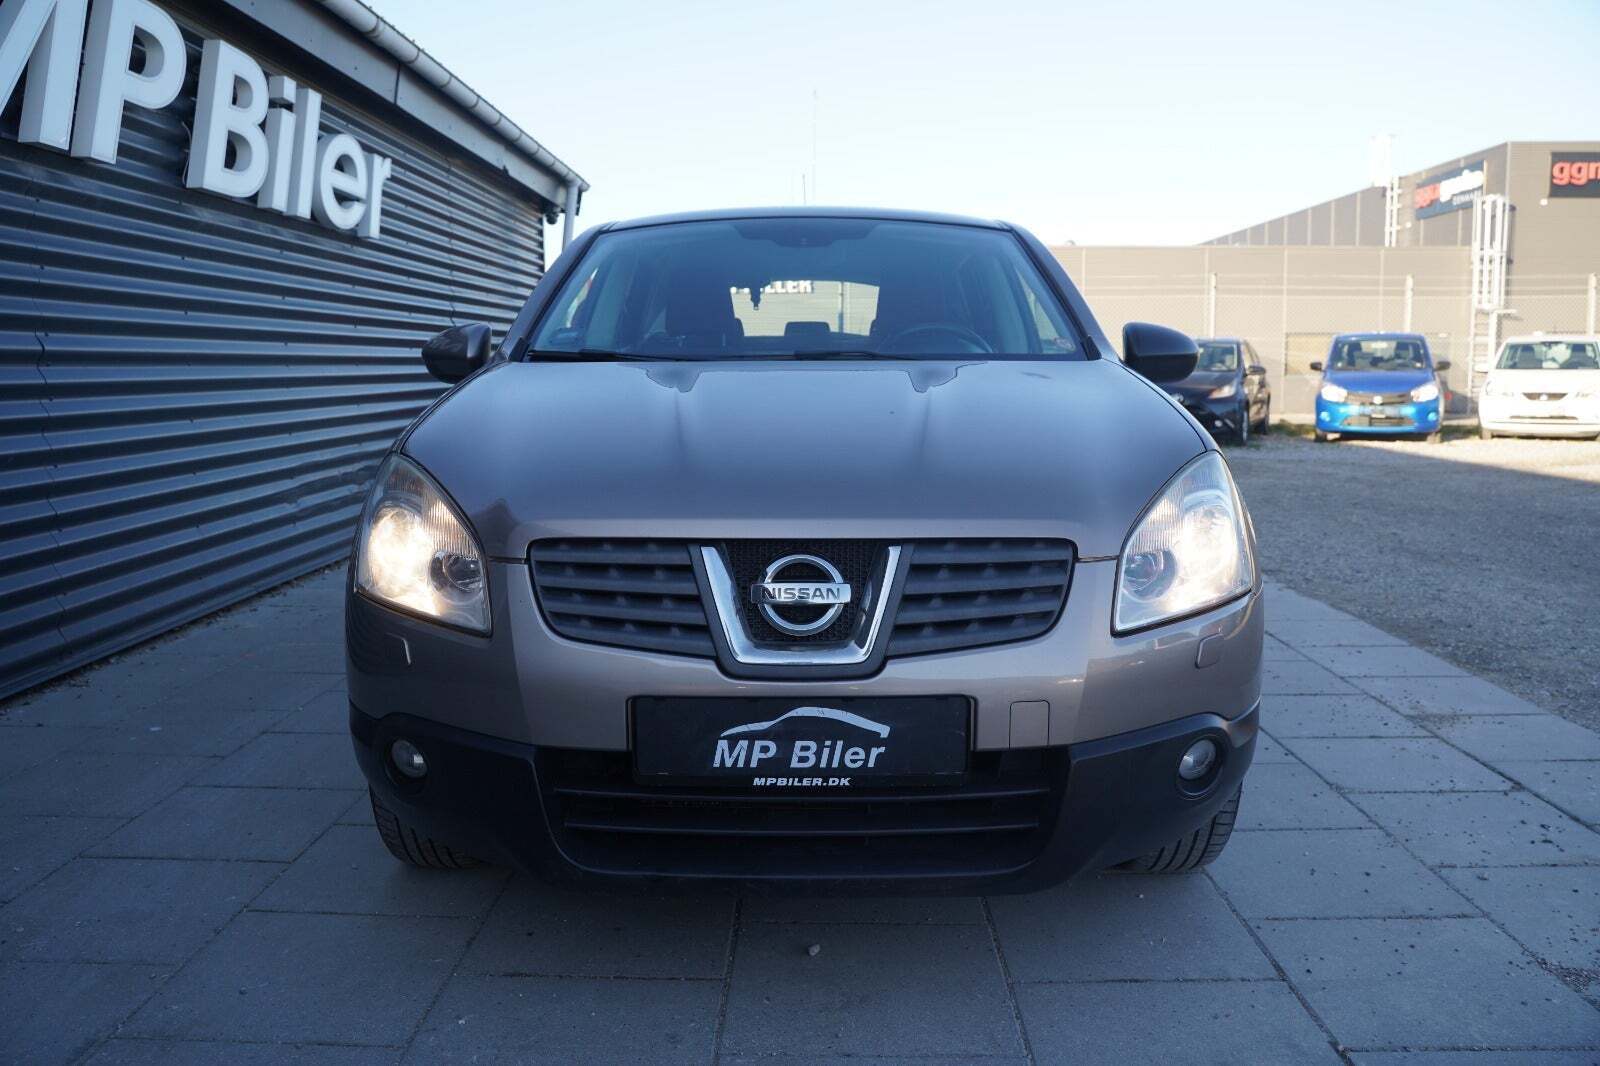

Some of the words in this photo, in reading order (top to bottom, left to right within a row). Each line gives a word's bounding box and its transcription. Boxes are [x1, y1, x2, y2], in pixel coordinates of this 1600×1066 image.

[186, 39, 392, 240] Biler
[761, 587, 840, 600] NISSAN
[712, 740, 777, 768] MP
[790, 740, 886, 768] Biler
[752, 777, 851, 787] MPBILER.DK
